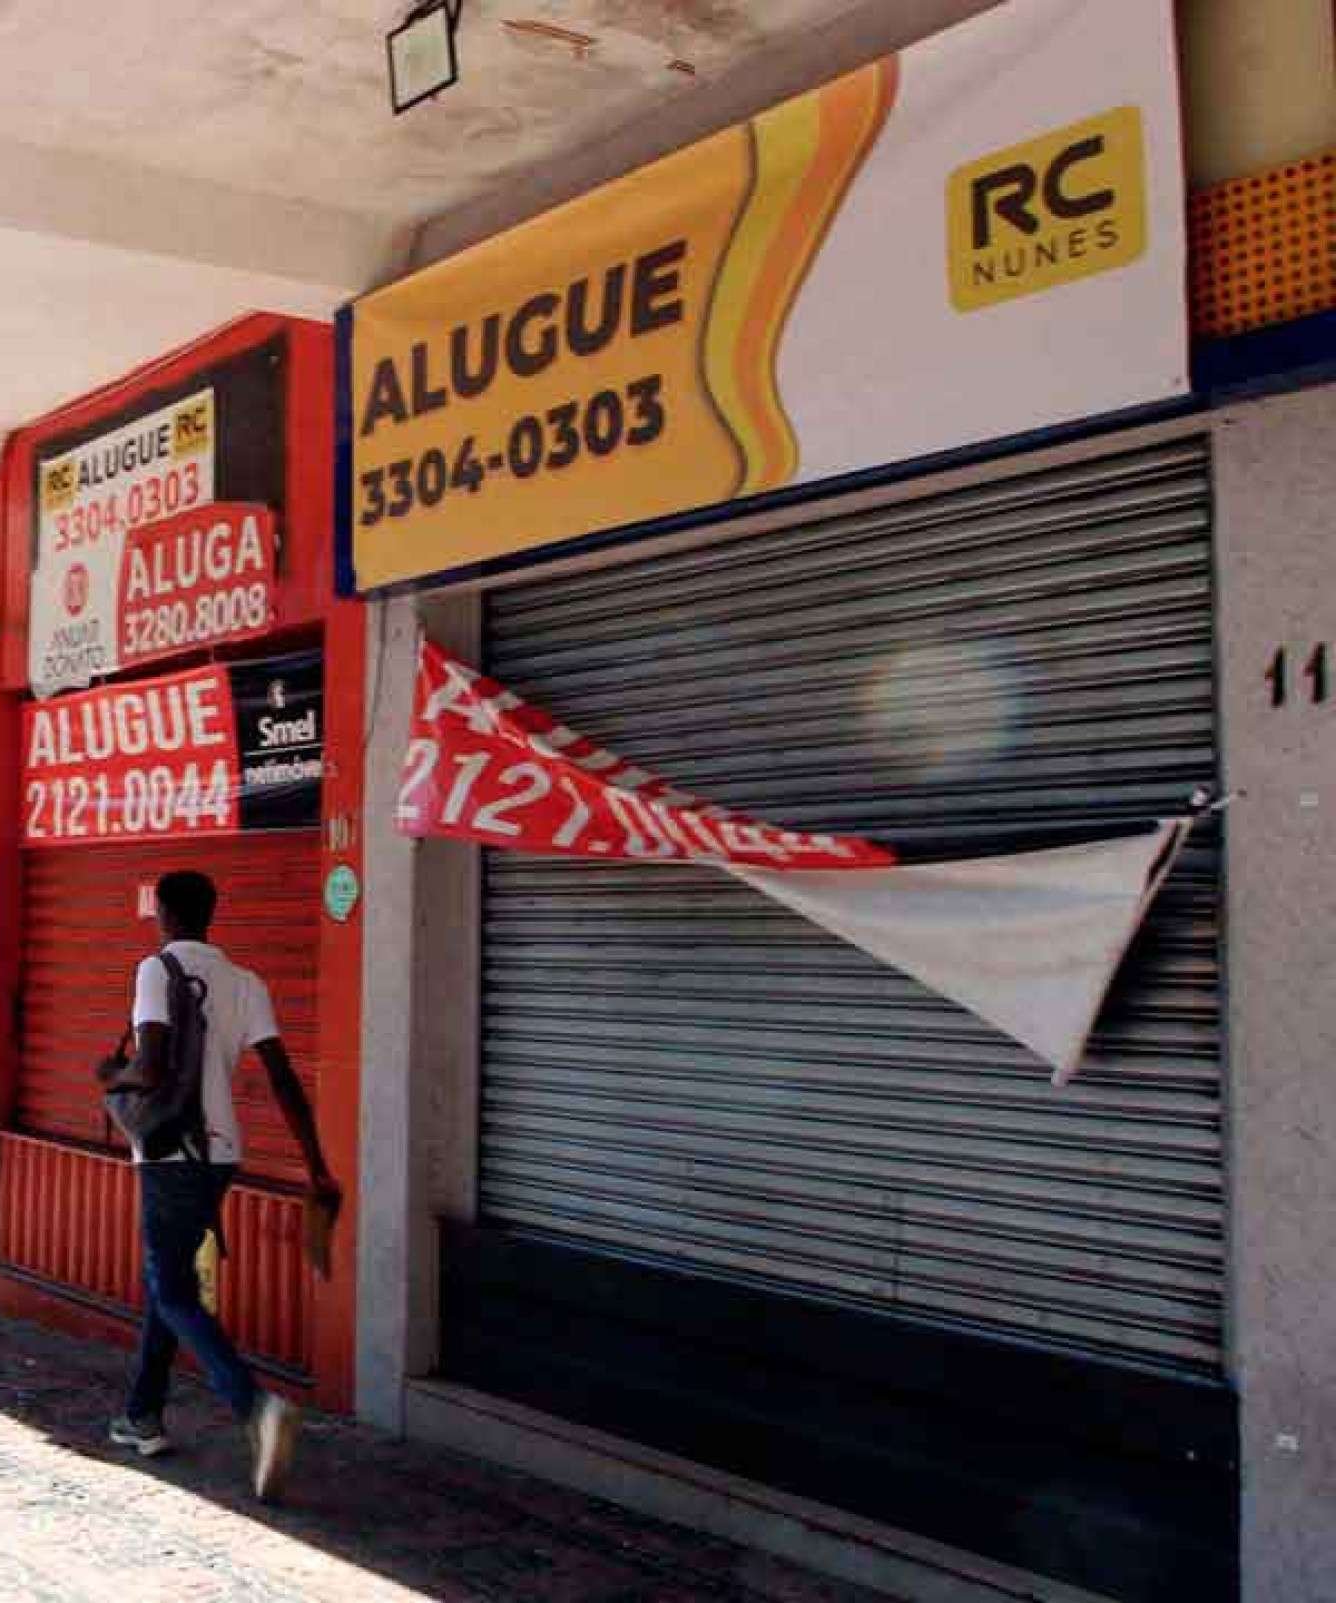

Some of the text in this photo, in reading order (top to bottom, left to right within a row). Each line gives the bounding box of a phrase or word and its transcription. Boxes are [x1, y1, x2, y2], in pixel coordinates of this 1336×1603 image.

[972, 134, 1114, 250] RC
[973, 219, 1118, 286] NUNES
[360, 241, 687, 436] ALUGUE
[77, 423, 170, 487] ALUGUE
[359, 374, 665, 527] 3304-0303
[127, 516, 264, 602] ALUGA
[27, 677, 224, 768] ALUGUE
[259, 710, 316, 747] Smel
[25, 758, 232, 838] 2121.0044
